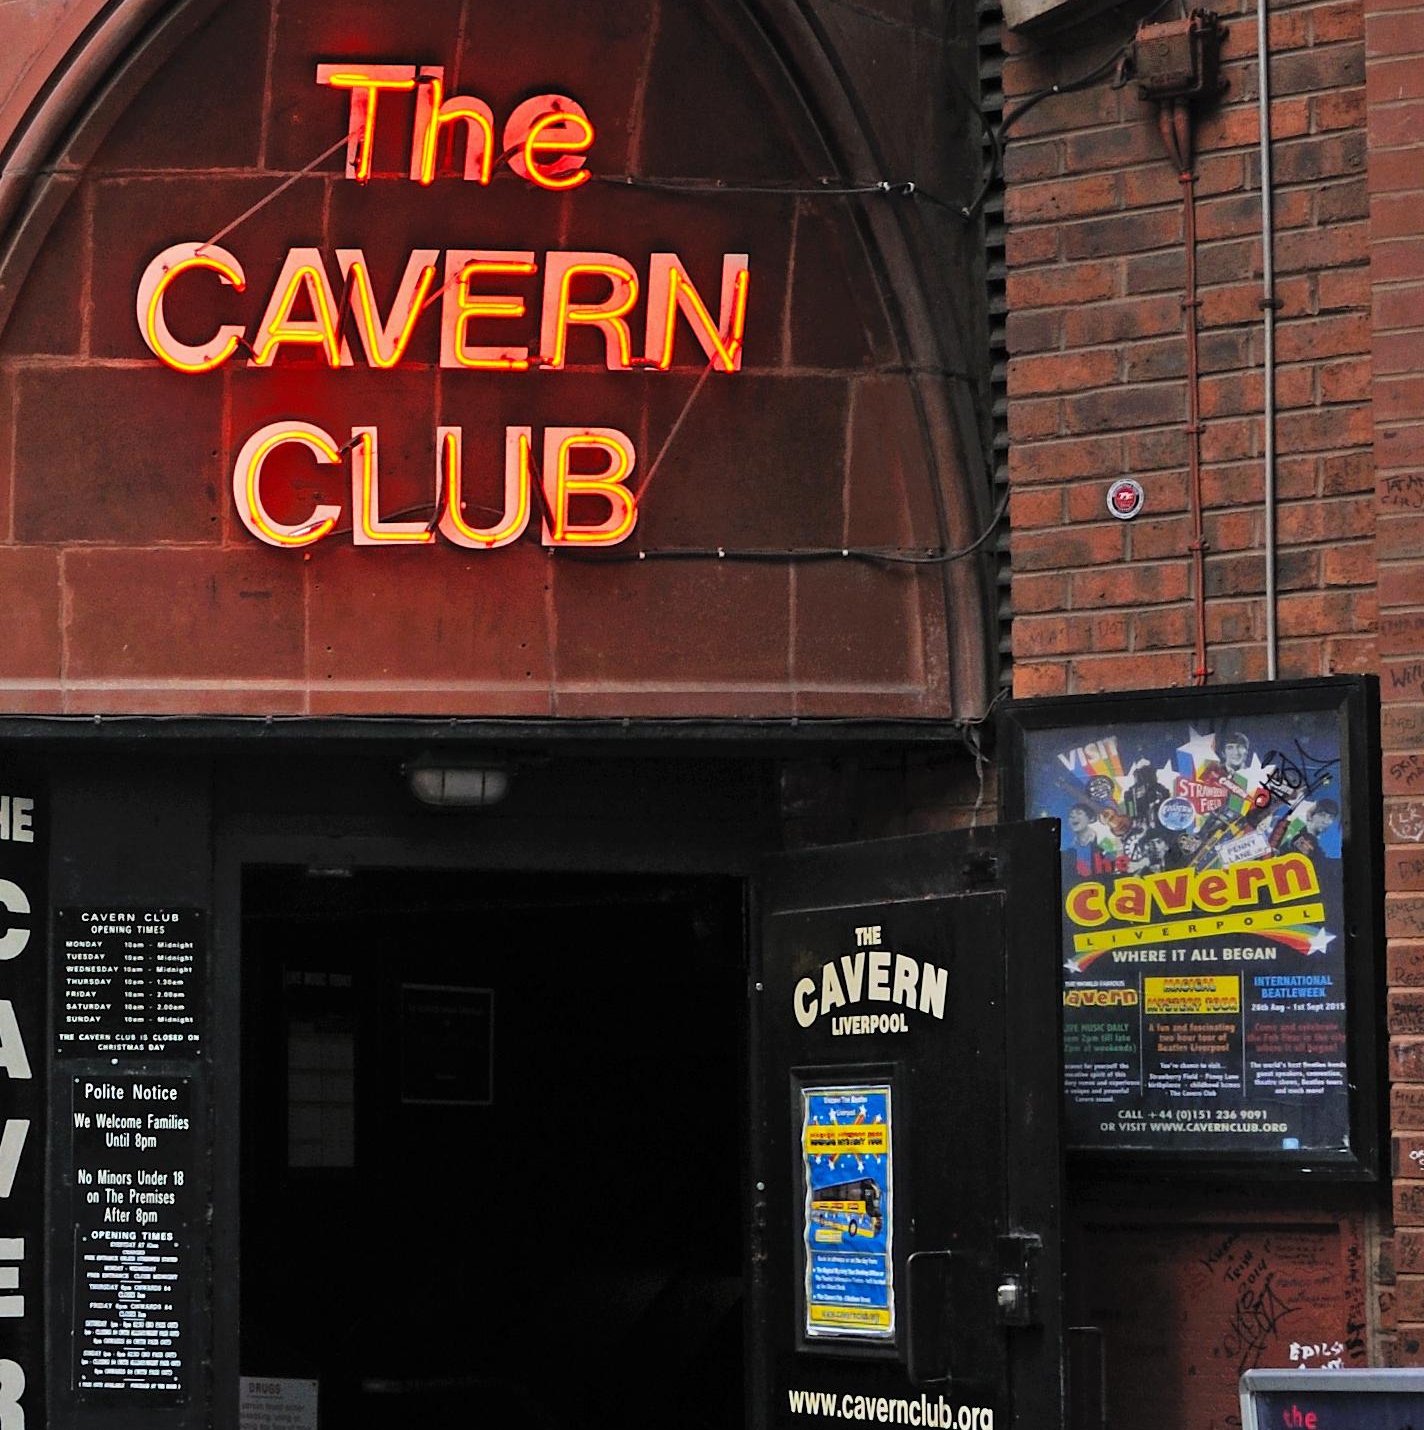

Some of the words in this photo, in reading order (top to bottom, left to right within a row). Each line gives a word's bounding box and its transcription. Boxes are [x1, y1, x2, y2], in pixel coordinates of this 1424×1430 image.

[316, 63, 596, 191] The
[136, 241, 751, 374] CAVERN
[233, 421, 640, 550] CLUB
[1058, 734, 1119, 772] VISIT
[1065, 852, 1321, 927] cavern
[81, 912, 136, 922] CAVERN
[144, 913, 179, 922] CLUB
[91, 925, 132, 934] OPENING
[137, 925, 166, 934] TIMES
[855, 925, 882, 947] THE
[1086, 910, 1311, 946] LIVERPOOL
[1112, 949, 1167, 963] WHERE
[1172, 949, 1186, 962] IT
[1190, 949, 1218, 962] ALL
[1222, 947, 1277, 961] BEGAN
[1163, 977, 1217, 992] MAGICAL
[1254, 975, 1333, 986] INTERNATIONAL
[793, 951, 949, 1028] CAVERN
[1063, 989, 1138, 1007] avern
[1261, 987, 1326, 999] BEATLEWEEK
[1146, 996, 1202, 1012] MYSTERY
[1205, 996, 1238, 1012] TOUR
[1307, 1002, 1324, 1012] Sept
[831, 1013, 909, 1036] LIVERPOOL
[1107, 1023, 1130, 1032] DAILY
[97, 1043, 144, 1051] CHRISTMAS
[148, 1043, 165, 1051] DAY
[85, 1083, 125, 1100] Polite
[132, 1083, 178, 1101] Notice
[74, 1113, 91, 1129] We
[96, 1113, 142, 1129] Welcome
[147, 1113, 189, 1130] Families
[1117, 1110, 1144, 1120] CALL
[1147, 1110, 1173, 1120] +44
[1176, 1109, 1212, 1122] (0)151
[1216, 1110, 1237, 1120] 236
[1240, 1110, 1268, 1120] 9091
[1100, 1122, 1116, 1132] OR
[1118, 1122, 1147, 1132] VISIT
[1149, 1122, 1288, 1133] WWW.CAVERNCLUB.ORG
[105, 1132, 130, 1148] Until
[135, 1133, 157, 1152] 8pm
[77, 1169, 92, 1185] No
[97, 1169, 132, 1185] Minors
[137, 1170, 168, 1186] Under
[173, 1170, 185, 1186] 18
[86, 1190, 100, 1204] on
[104, 1187, 124, 1204] The
[129, 1188, 176, 1205] Premises
[104, 1206, 131, 1222] After
[136, 1208, 158, 1226] 8pm
[91, 1230, 136, 1240] OPENING
[141, 1231, 174, 1241] TIMES
[248, 1381, 281, 1395] DRUGS
[1282, 1404, 1318, 1430] the
